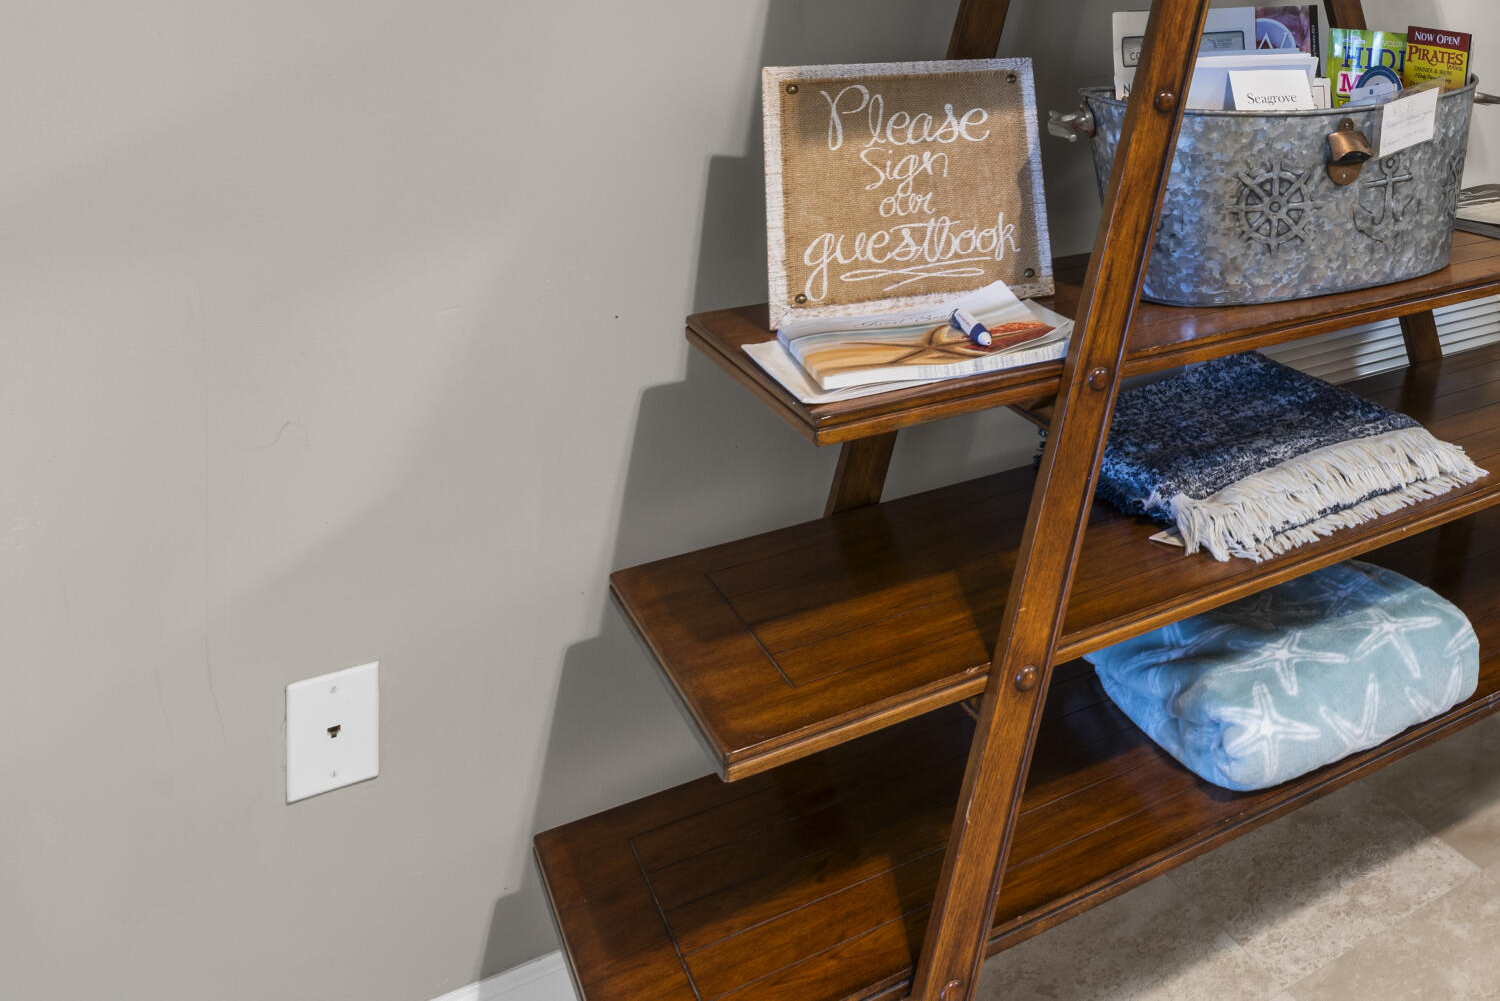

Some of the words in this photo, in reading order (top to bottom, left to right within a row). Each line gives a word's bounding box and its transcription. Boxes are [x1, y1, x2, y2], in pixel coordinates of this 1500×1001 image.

[1407, 45, 1464, 66] PIRATES
[820, 84, 990, 150] Please
[1246, 92, 1297, 105] Seagrove
[803, 212, 1021, 301] guestbook
